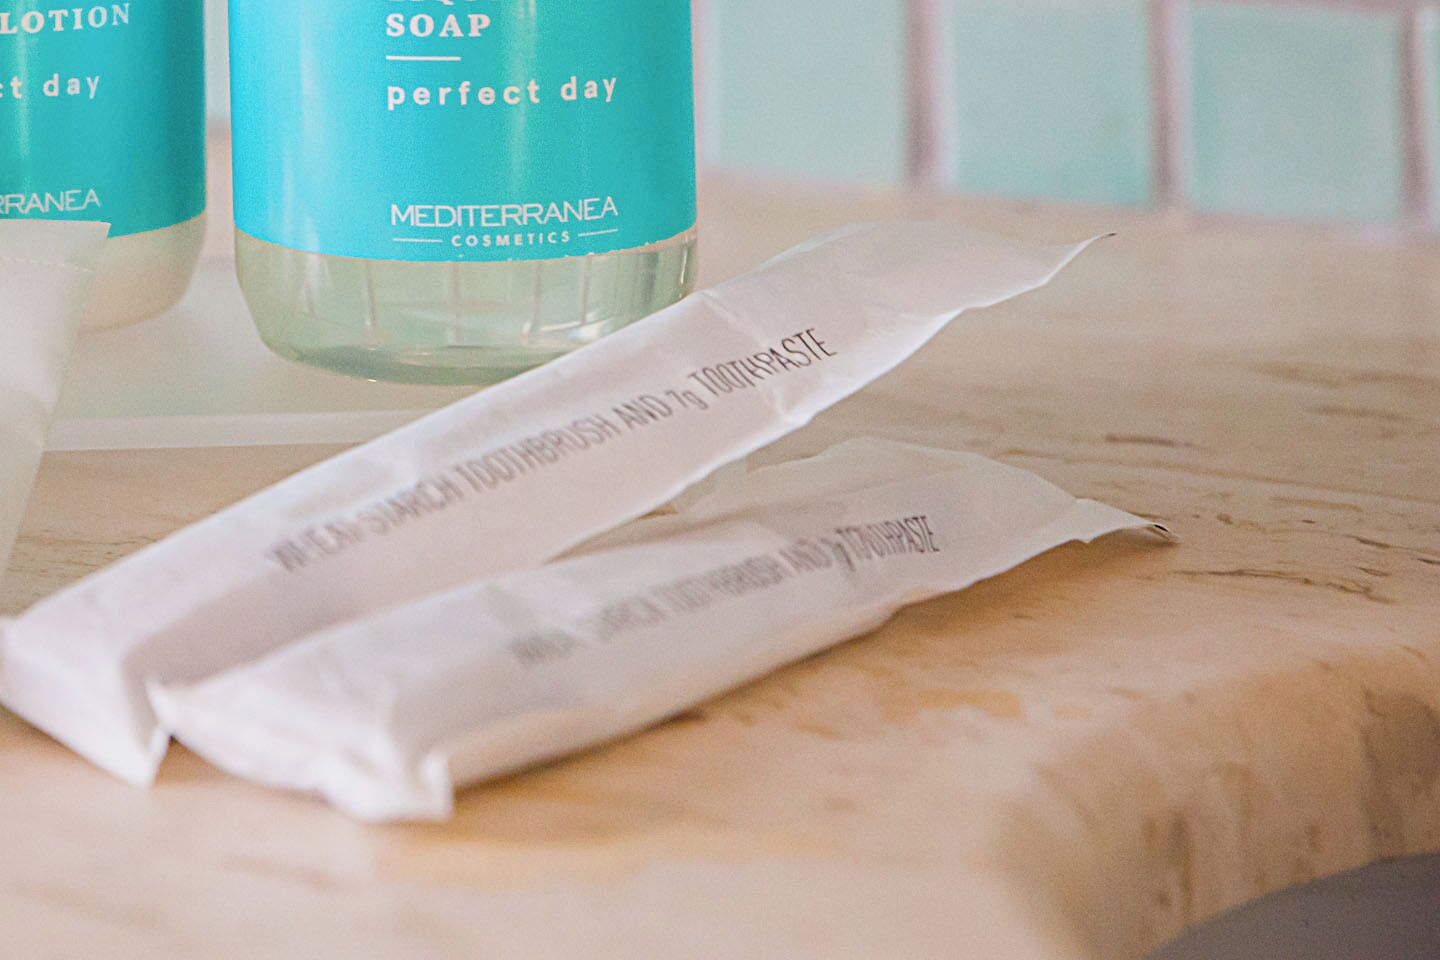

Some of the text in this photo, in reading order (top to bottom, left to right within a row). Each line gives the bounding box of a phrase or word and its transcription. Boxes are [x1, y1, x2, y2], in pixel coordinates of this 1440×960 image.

[385, 13, 492, 38] SOAP
[43, 73, 100, 98] day
[387, 76, 617, 110] perfect day
[391, 196, 619, 228] MEDITERRANEA
[450, 230, 571, 248] COSMETICS
[686, 327, 838, 398] TOOTHPASTE
[612, 393, 674, 431] AND
[666, 389, 710, 411] 7g
[452, 411, 621, 494] TOOTHBRUSH
